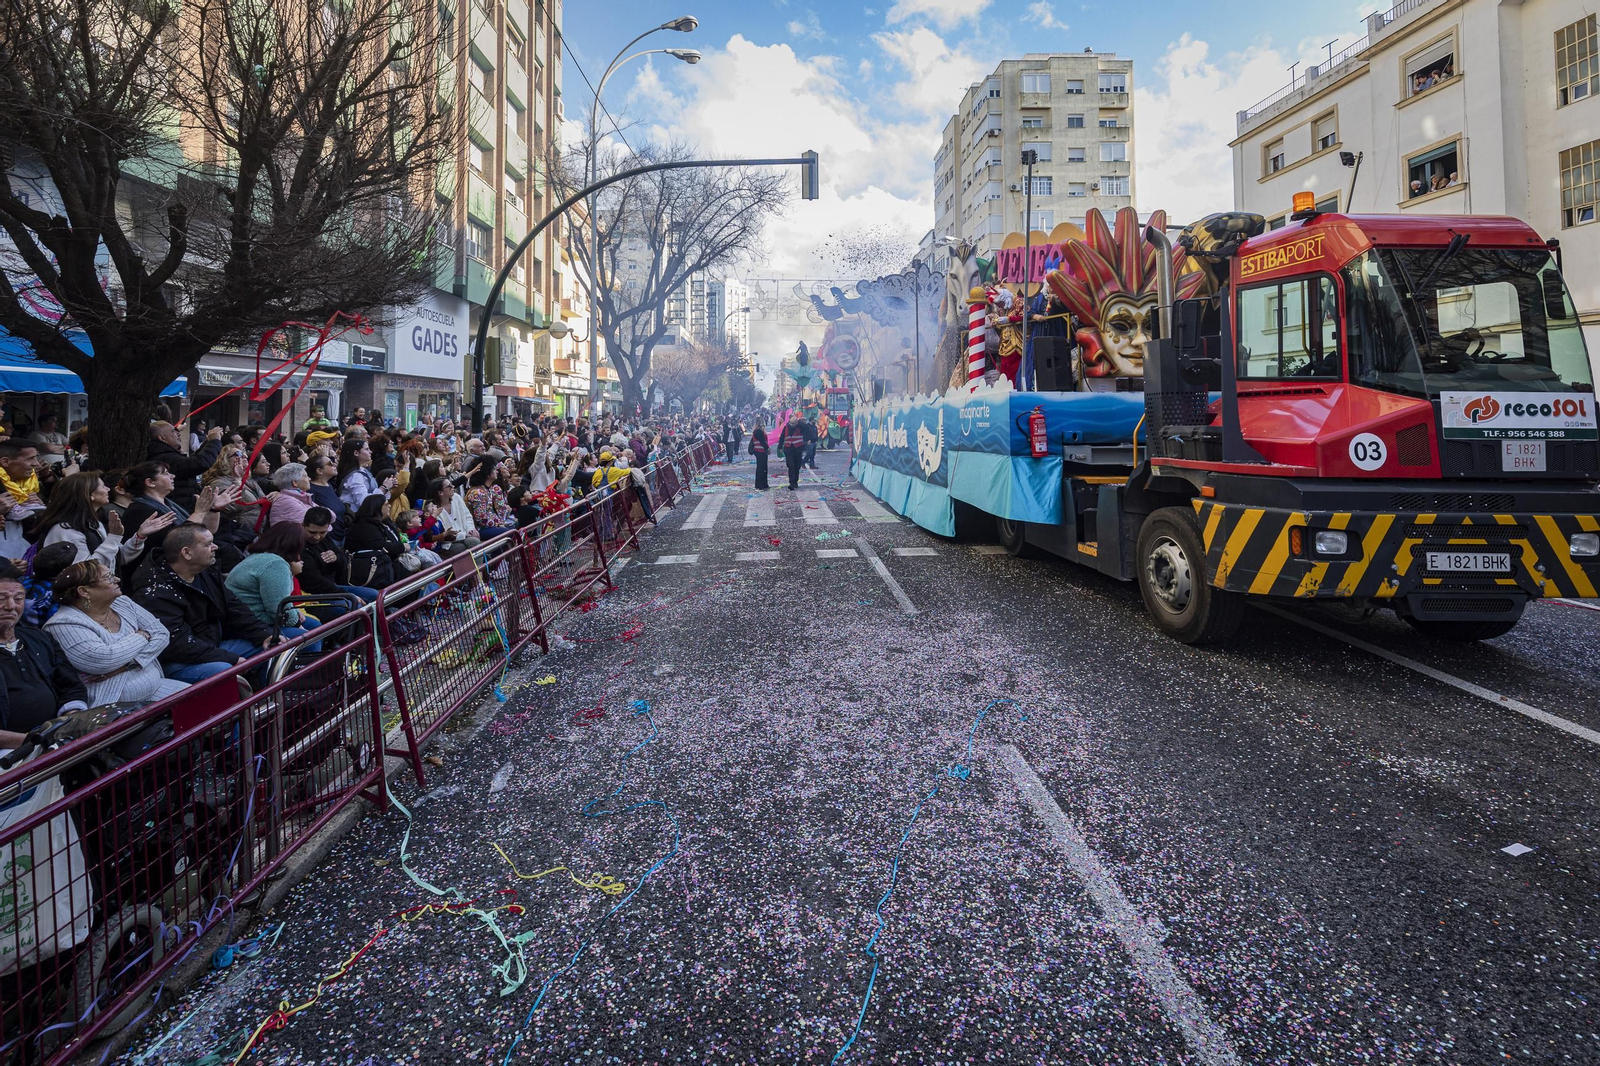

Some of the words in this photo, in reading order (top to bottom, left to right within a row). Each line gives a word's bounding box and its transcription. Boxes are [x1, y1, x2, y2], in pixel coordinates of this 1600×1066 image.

[1241, 235, 1326, 276] ESTIBAPORT
[416, 306, 455, 327] AUTOESCUELA
[412, 325, 458, 358] GADES
[387, 377, 408, 388] CENTRO
[409, 379, 416, 388] DE
[1504, 398, 1587, 417] recoSOL
[1482, 430, 1505, 438] TLF.:
[1507, 430, 1526, 438] 956
[1528, 430, 1546, 438] 546
[1547, 430, 1565, 438] 388
[1354, 441, 1382, 462] 03
[1506, 443, 1513, 455] E
[1518, 443, 1542, 455] 1821
[1514, 457, 1536, 468] BHK
[1430, 554, 1439, 569] E
[1446, 555, 1478, 569] 1821
[1482, 555, 1508, 570] BHK
